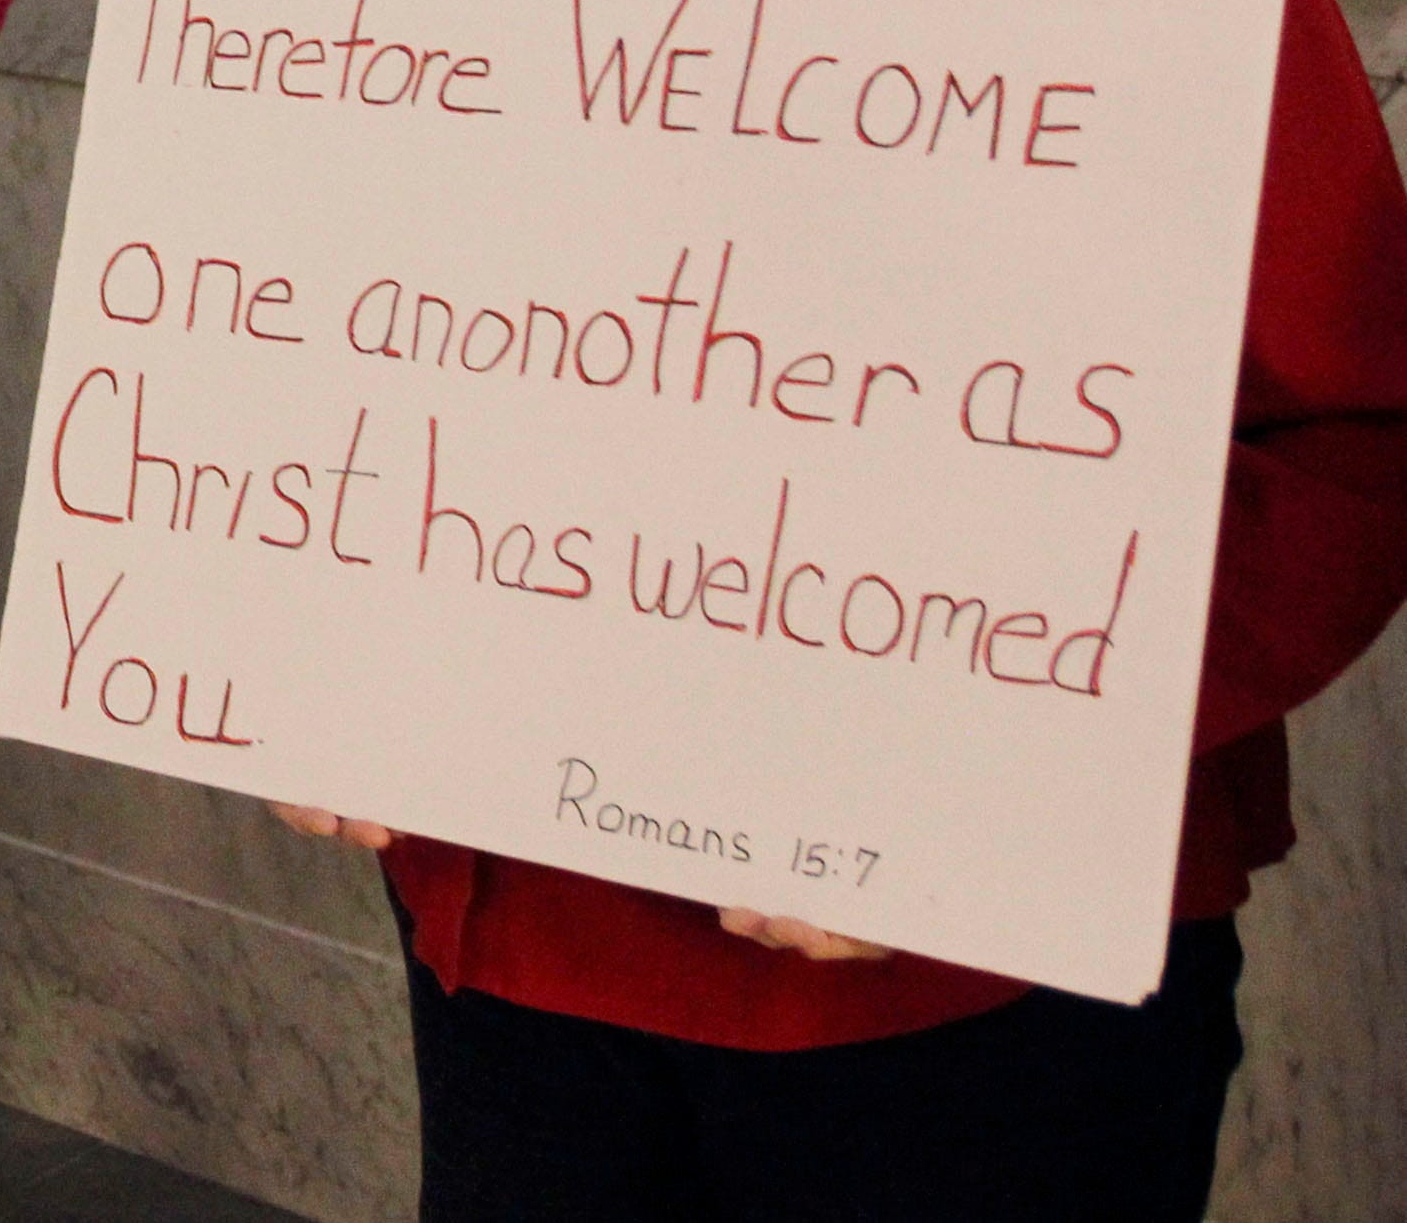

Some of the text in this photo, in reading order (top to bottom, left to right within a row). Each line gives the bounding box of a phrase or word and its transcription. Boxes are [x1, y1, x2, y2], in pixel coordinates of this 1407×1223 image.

[99, 240, 1134, 460] one anonother as
[51, 366, 1139, 699] Christ has welcomed
[558, 757, 881, 887] Romans 15:7
